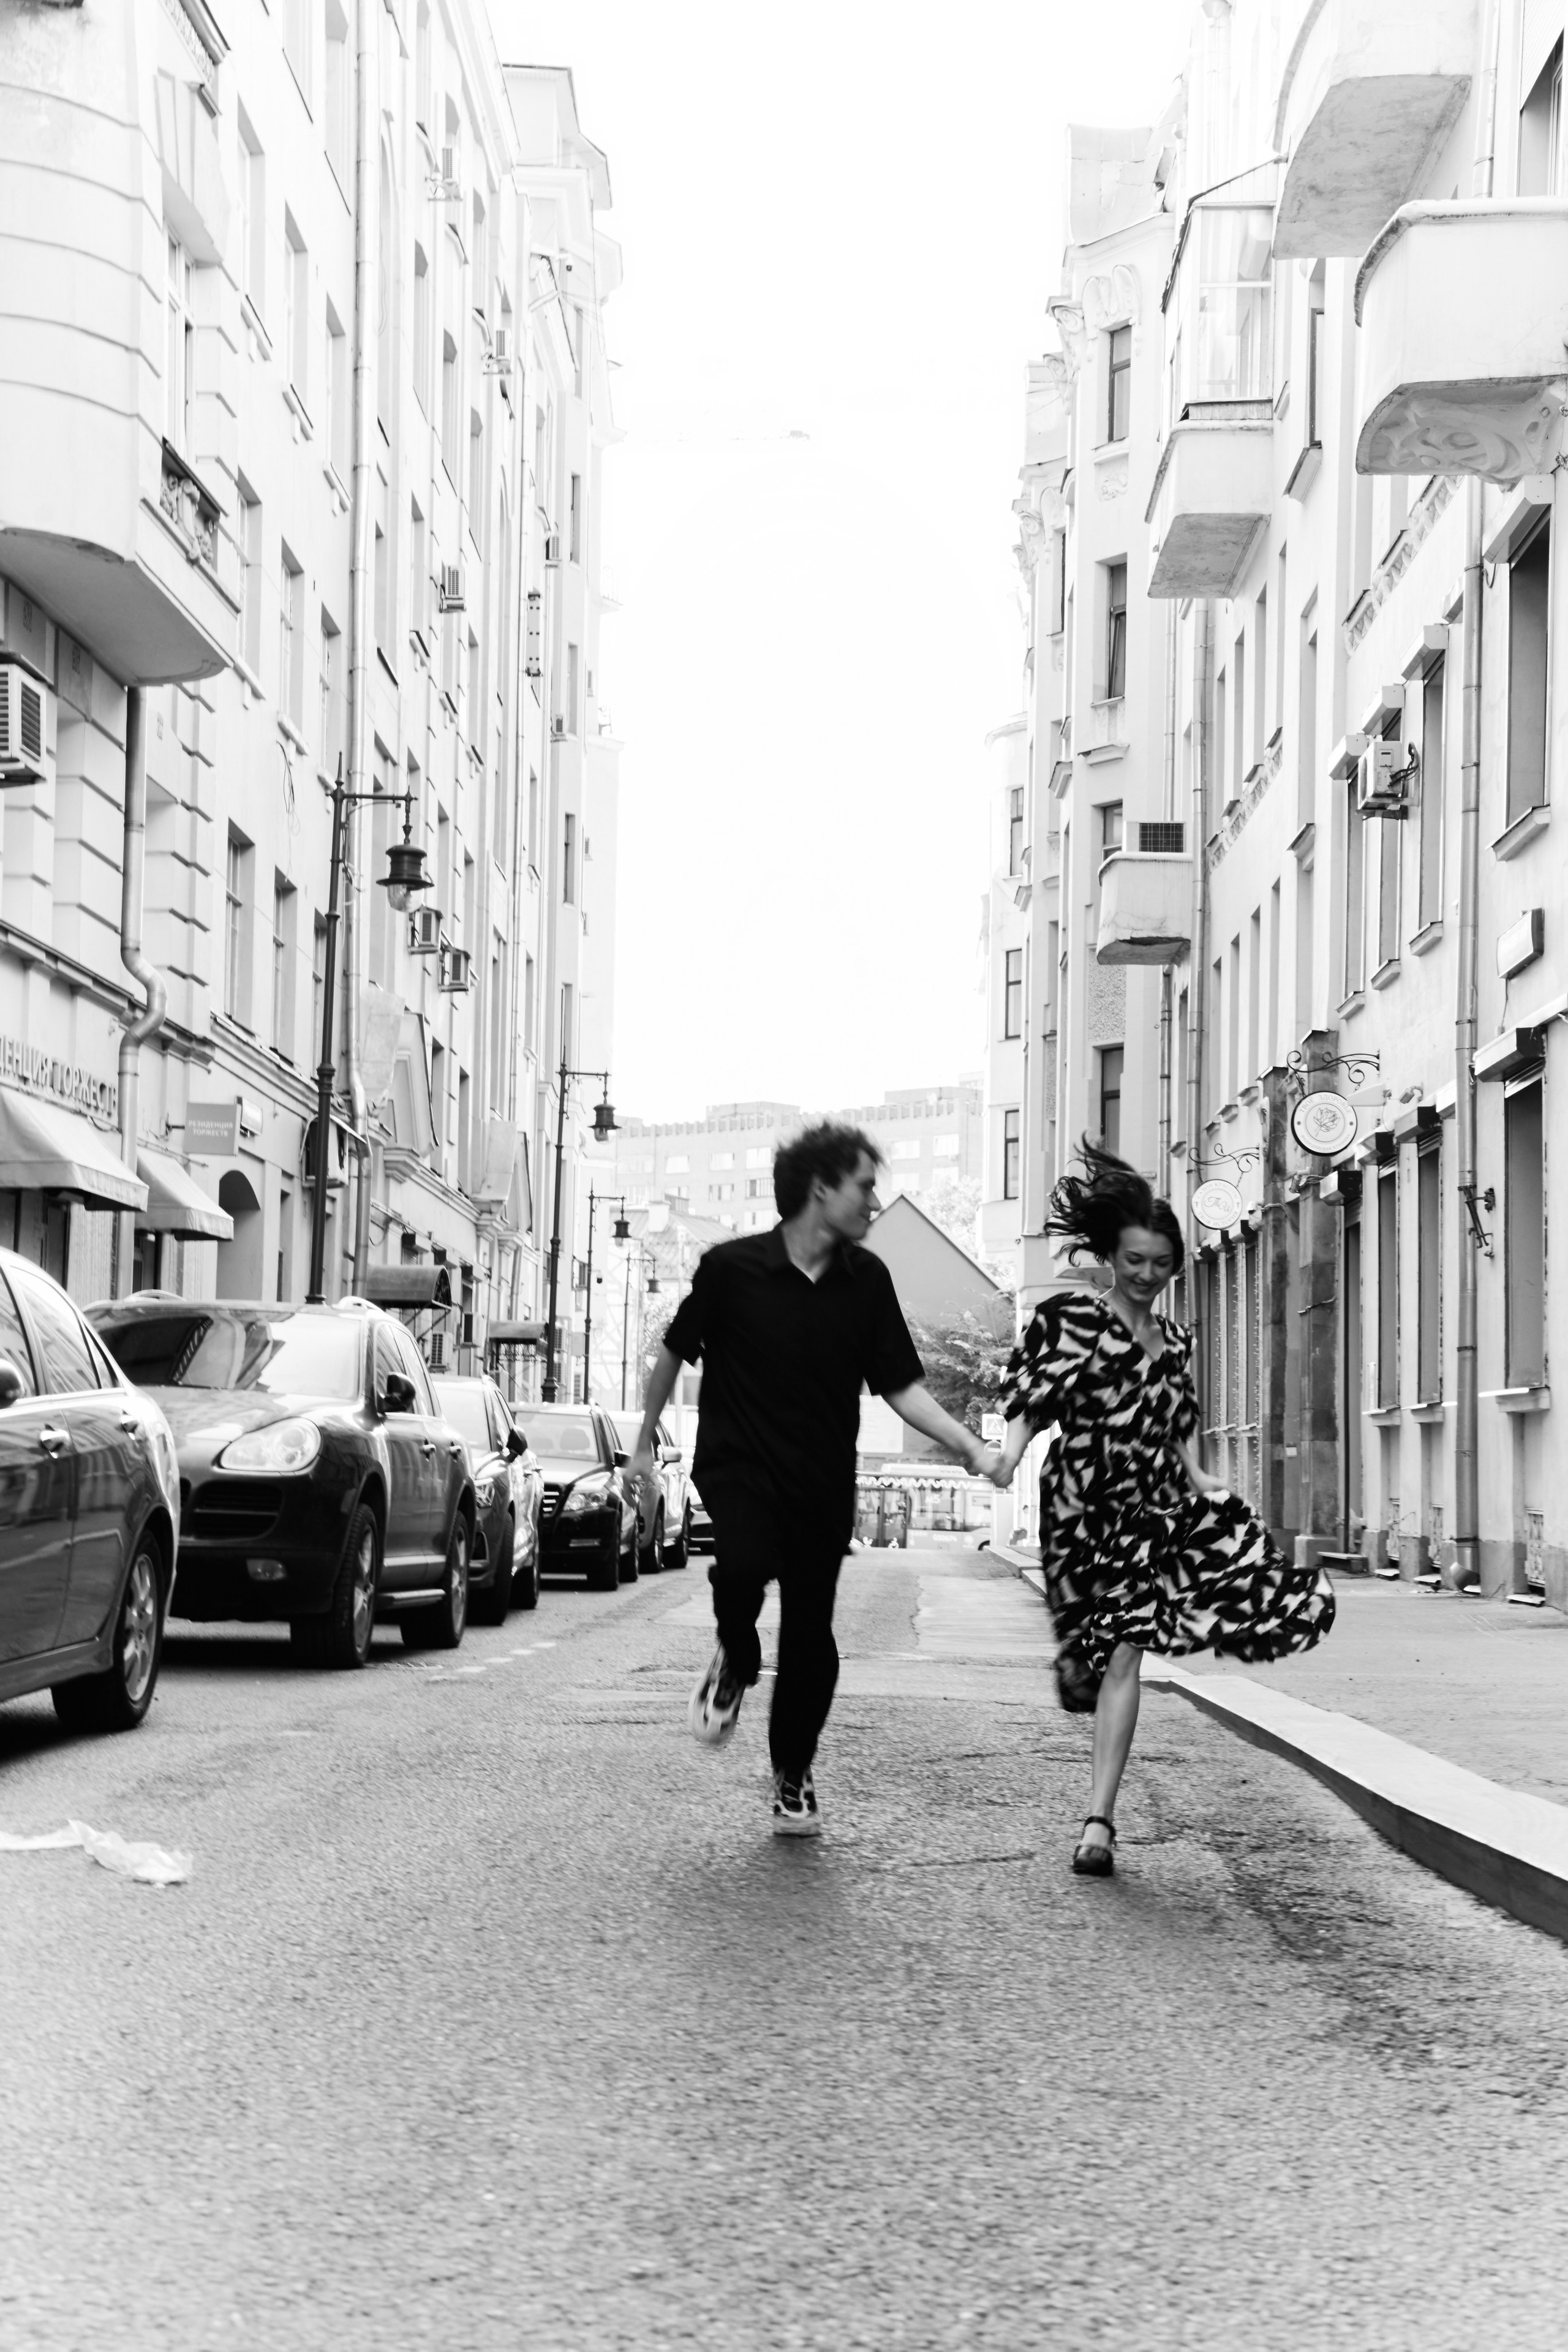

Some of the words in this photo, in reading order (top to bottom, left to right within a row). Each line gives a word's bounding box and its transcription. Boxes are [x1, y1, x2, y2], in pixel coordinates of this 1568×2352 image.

[1318, 1094, 1352, 1115] ЗДОРОВЬЕ
[189, 1120, 233, 1129] РЕЗИДЕНЦИЯ
[194, 1128, 228, 1137] ТОРЖЕСТВ
